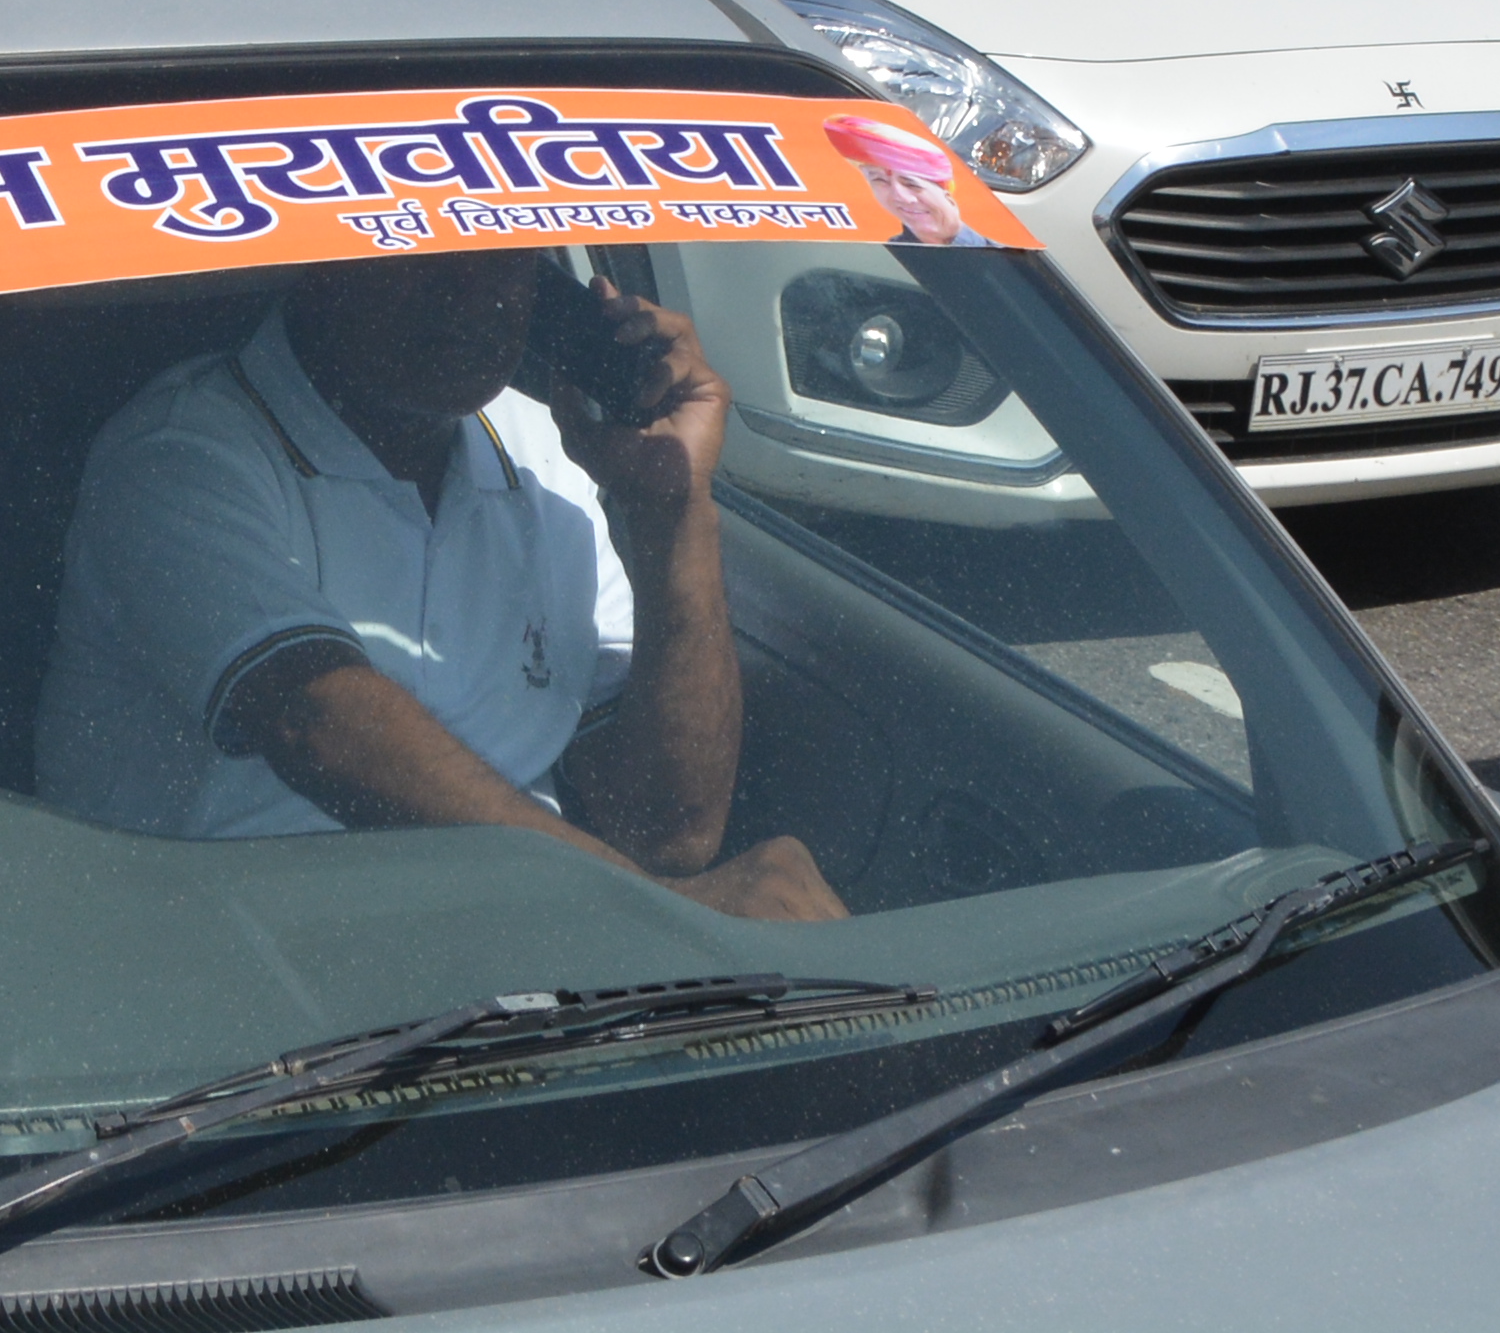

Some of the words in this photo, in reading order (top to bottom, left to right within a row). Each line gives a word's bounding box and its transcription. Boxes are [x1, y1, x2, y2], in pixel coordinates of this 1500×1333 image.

[80, 95, 806, 243] मुरावतिया
[338, 199, 432, 251] पूर्व
[443, 197, 655, 237] विधायक
[662, 199, 859, 231] मकराना
